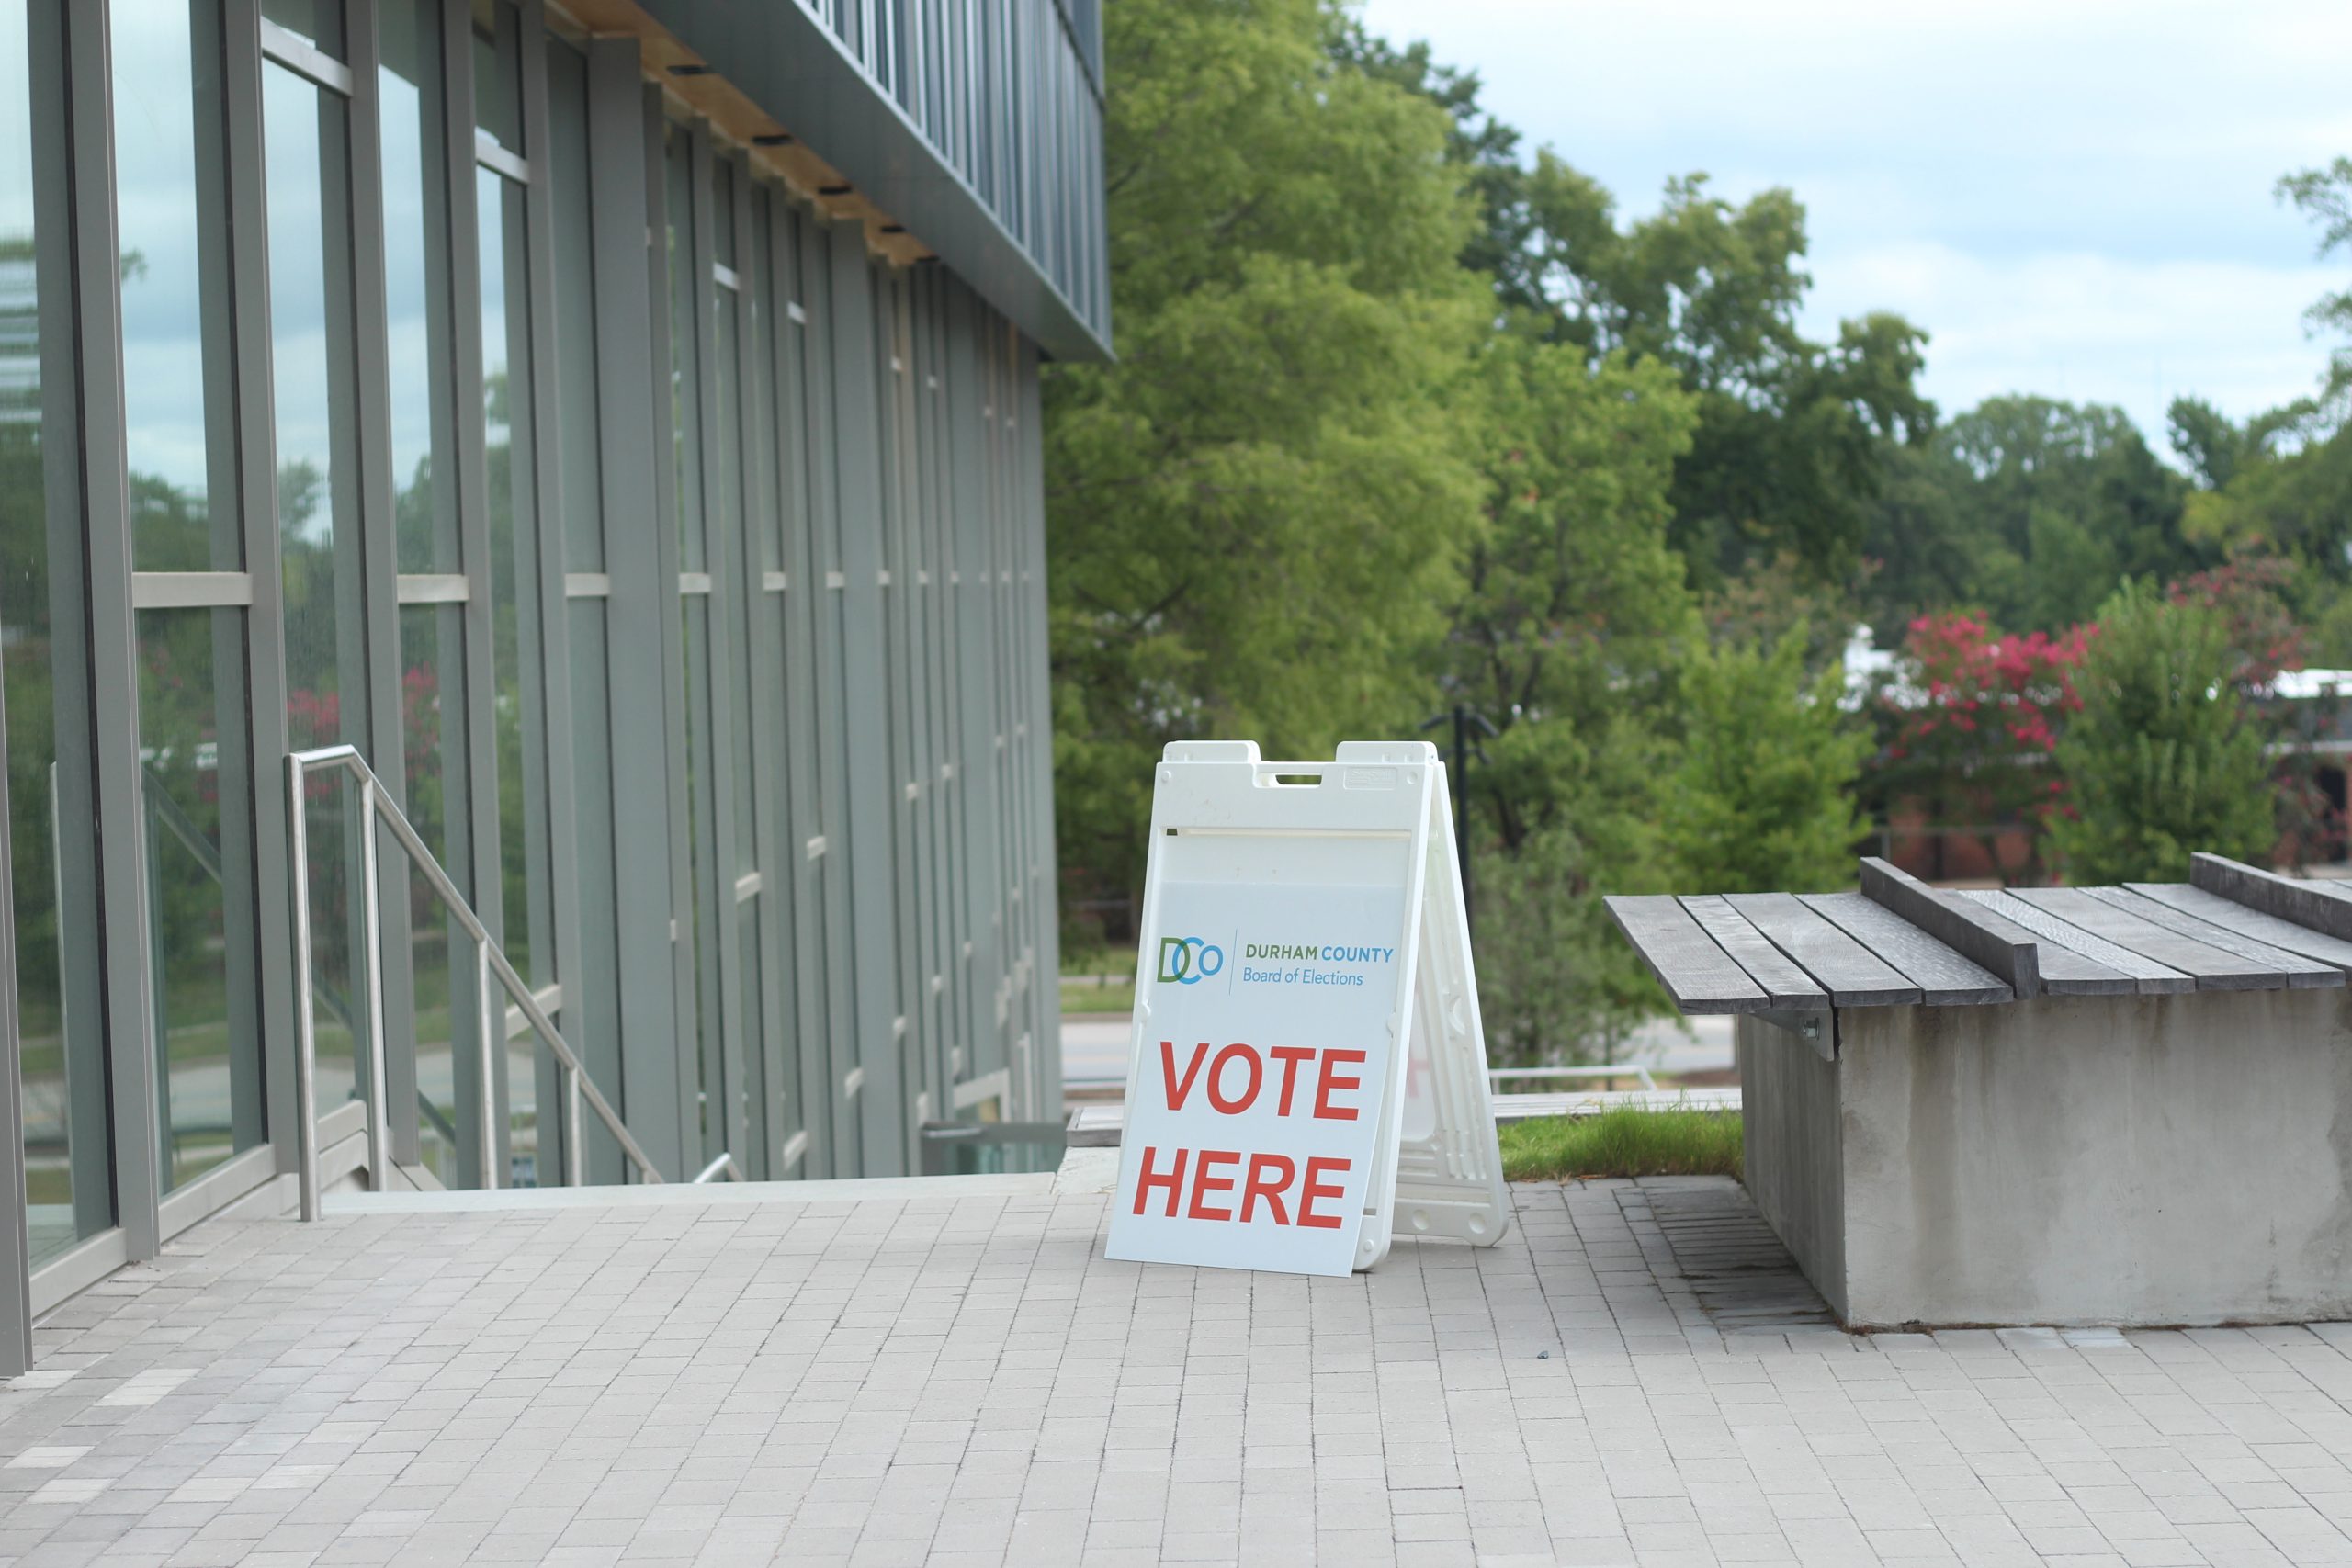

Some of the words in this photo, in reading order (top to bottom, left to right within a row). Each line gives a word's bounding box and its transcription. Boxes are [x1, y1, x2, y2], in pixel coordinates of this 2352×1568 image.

[1243, 967, 1283, 984] Board
[1284, 967, 1299, 984] of
[1302, 969, 1363, 986] Elections
[1246, 943, 1318, 961] DURHAM
[1321, 945, 1395, 964] COUNTY
[1160, 1042, 1366, 1121] VOTE
[1133, 1146, 1351, 1229] HERE
